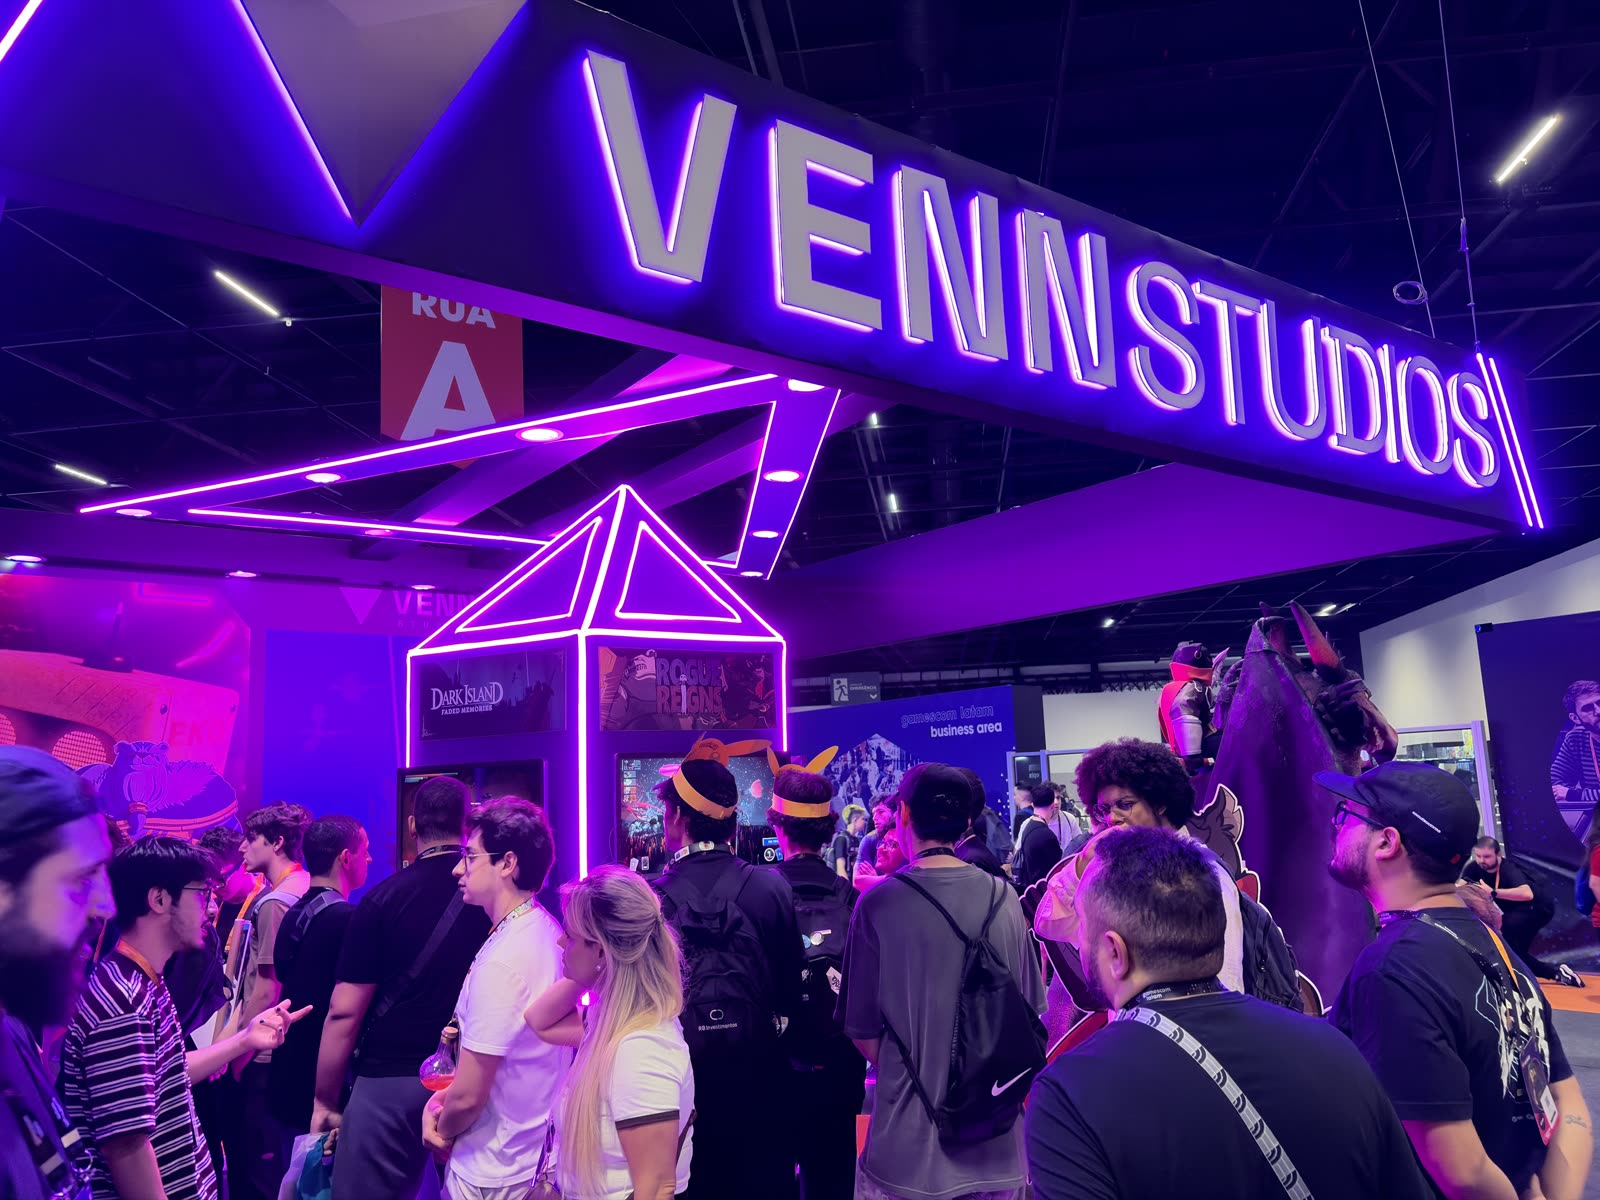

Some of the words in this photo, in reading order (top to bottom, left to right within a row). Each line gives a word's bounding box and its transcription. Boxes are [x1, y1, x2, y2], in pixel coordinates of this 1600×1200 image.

[583, 49, 1117, 390] VENN
[1127, 261, 1501, 488] STUDIOS
[412, 291, 497, 329] RUA
[400, 340, 497, 441] A
[656, 658, 723, 687] ROGUE
[430, 688, 463, 710] DARK
[464, 681, 504, 705] ISLAND
[441, 707, 460, 715] FADED
[461, 704, 493, 714] MEMORIES
[656, 685, 724, 716] REIGNS
[901, 709, 958, 729] gamescom
[959, 704, 994, 719] latam
[930, 724, 975, 738] business
[976, 722, 1002, 734] area
